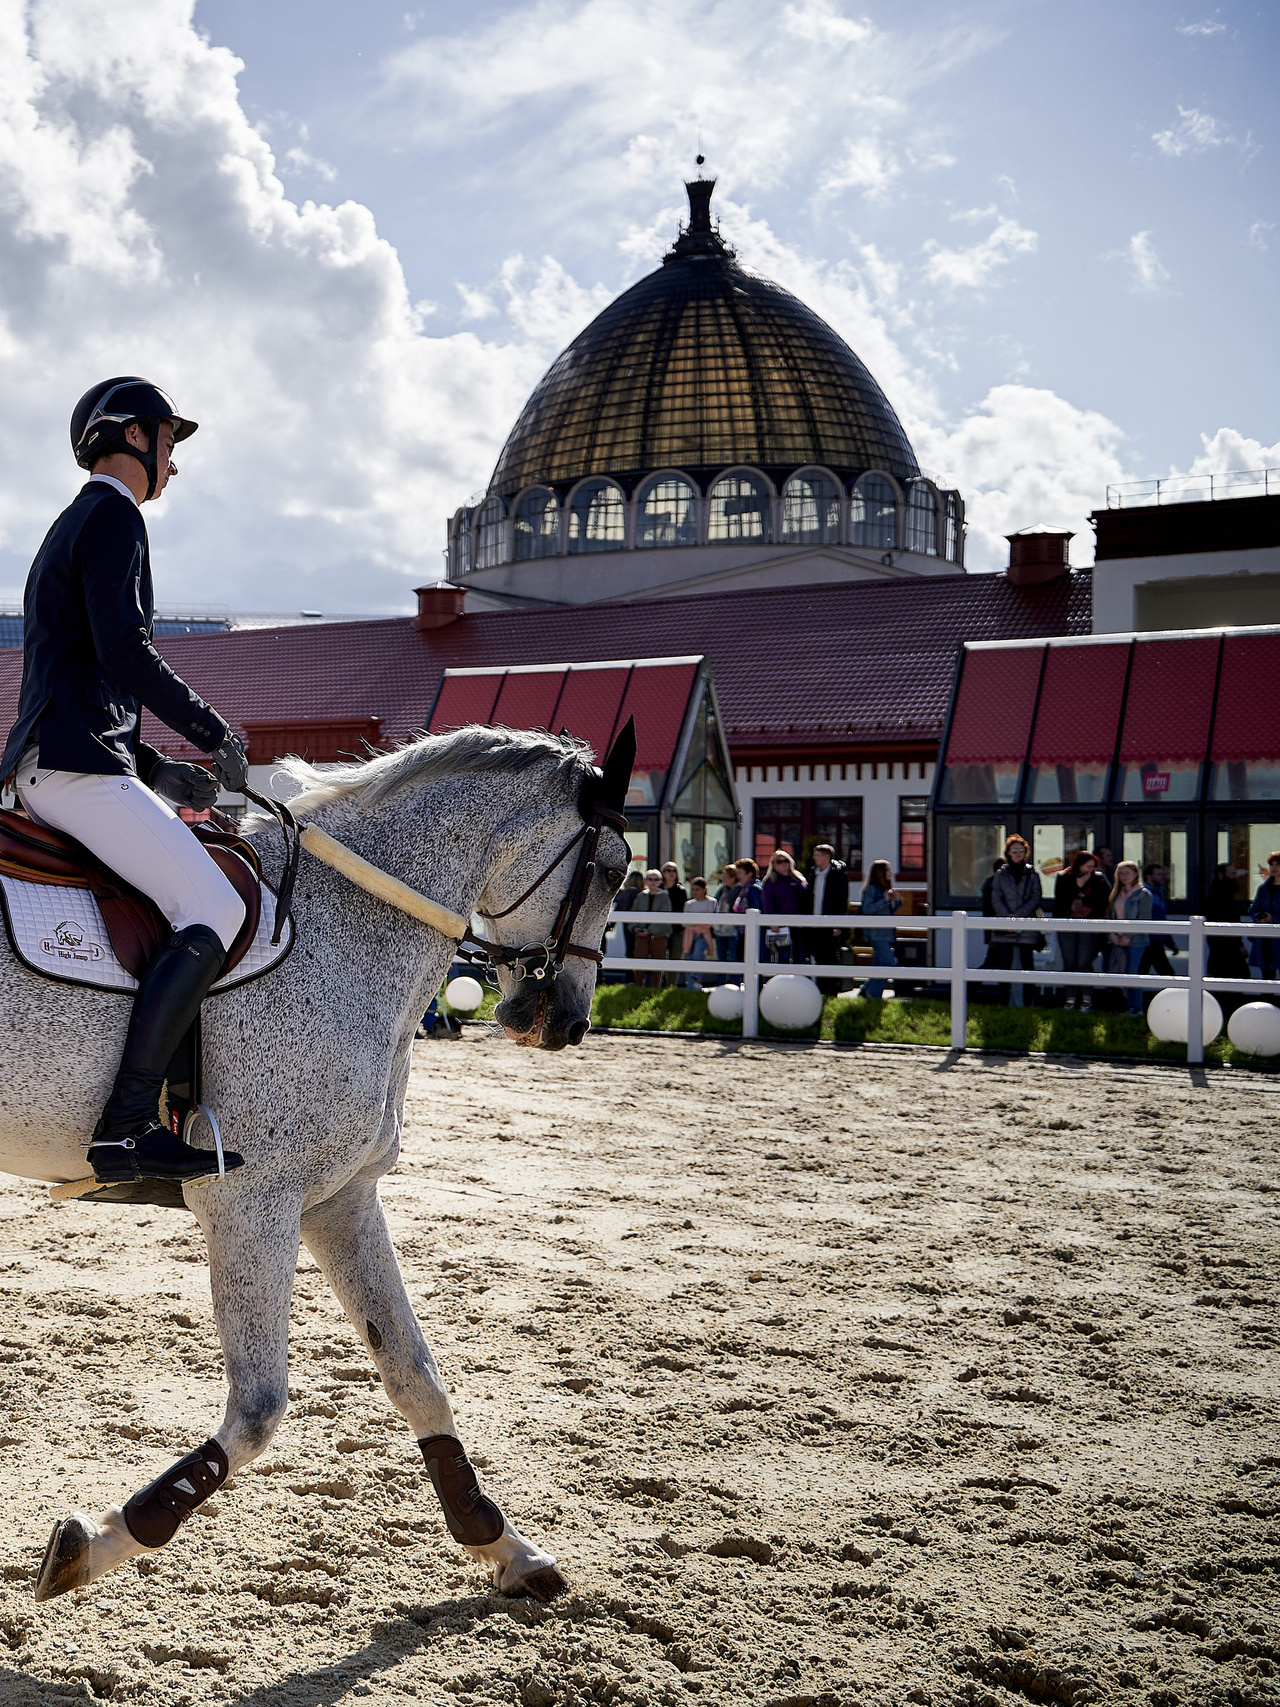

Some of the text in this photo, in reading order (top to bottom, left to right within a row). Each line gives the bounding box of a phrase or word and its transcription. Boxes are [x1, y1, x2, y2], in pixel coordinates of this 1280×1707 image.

[44, 942, 50, 951] H
[58, 950, 88, 961] High Jump
